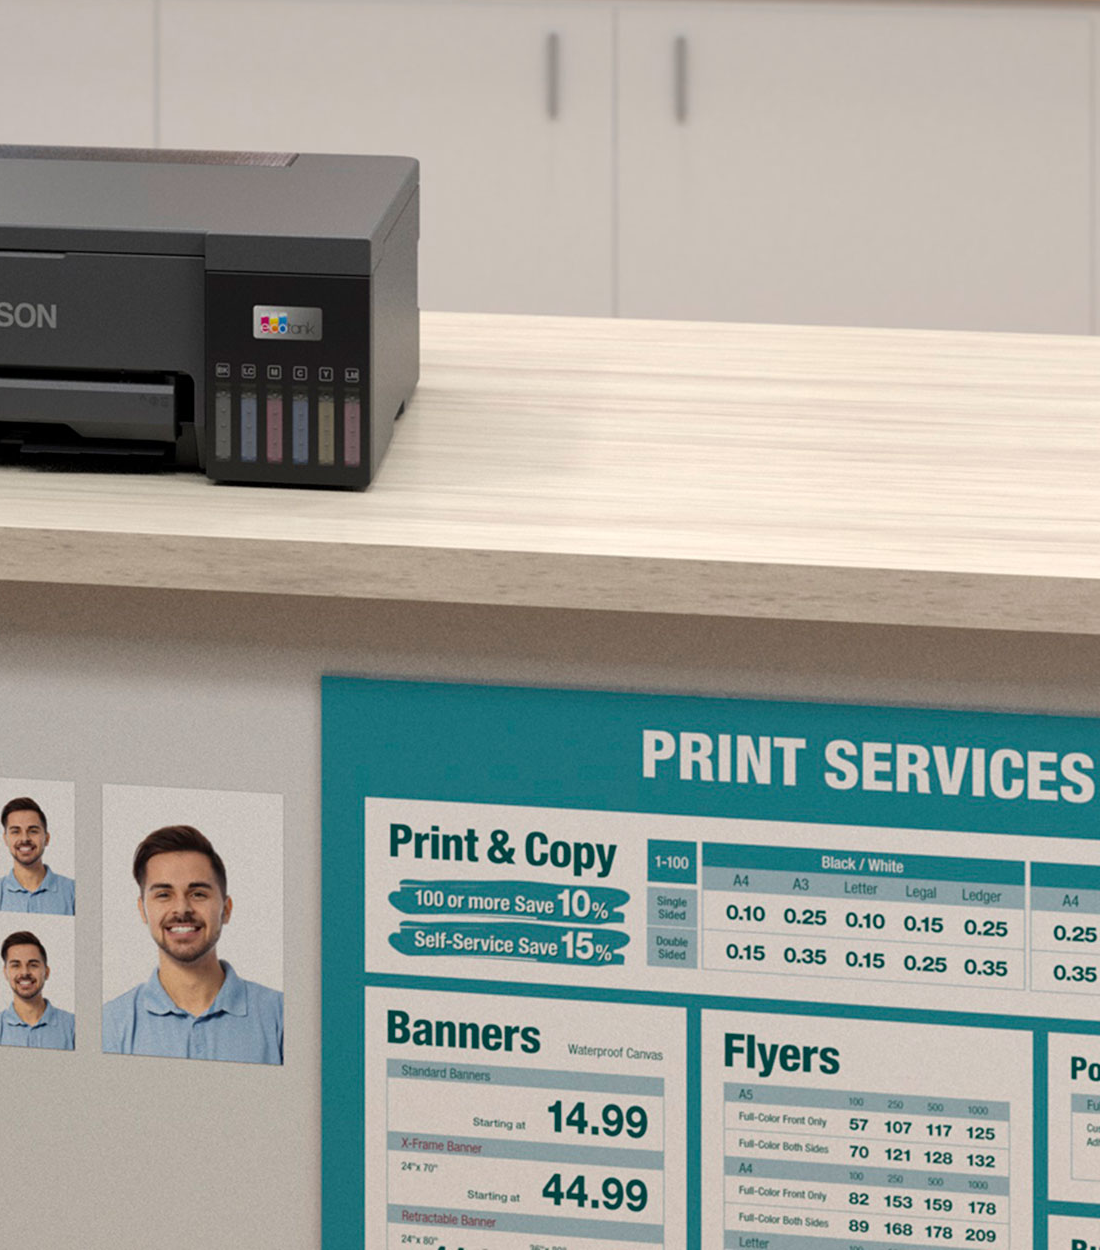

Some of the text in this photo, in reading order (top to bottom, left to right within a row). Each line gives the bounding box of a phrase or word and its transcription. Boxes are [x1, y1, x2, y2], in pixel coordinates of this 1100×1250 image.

[642, 729, 1095, 804] PRINT SERVICES
[389, 823, 617, 878] Print & Copy
[655, 855, 689, 870] 1-100
[821, 856, 857, 871] Black
[868, 858, 904, 874] White
[733, 874, 1002, 904] A4 A3 Letter Legal Ledger
[415, 888, 609, 919] 100 or more Save 10%
[656, 895, 687, 908] Single
[1062, 895, 1079, 908] A4
[658, 908, 686, 921] Sided
[726, 905, 1008, 938] 0.10 0.25 0.10 0.15 0.25
[656, 936, 688, 948] Double
[1053, 925, 1097, 943] 0.25
[414, 931, 612, 961] Self-Service Save 15%
[658, 948, 686, 961] Sided
[726, 944, 1008, 977] 0.15 0.35 0.15 0.25 0.35
[1053, 964, 1097, 983] 0.35
[387, 1009, 541, 1054] Banners
[568, 1043, 663, 1061] Waterproof Canvas
[724, 1033, 841, 1078] Flyers
[401, 1064, 491, 1081] Standard Banners
[1071, 1056, 1100, 1082] Po
[738, 1088, 753, 1100] A5
[848, 1097, 989, 1115] 100 250 500 1000
[473, 1116, 526, 1130] Starting at
[548, 1100, 648, 1139] 14.99
[738, 1111, 827, 1128] Full-Color Front Only
[849, 1118, 996, 1140] 57 107 117 125
[401, 1137, 482, 1154] X-Frame Banner
[738, 1138, 829, 1154] Full-Color Both Sides
[849, 1145, 996, 1168] 70 121 128 132
[738, 1162, 753, 1174] A4
[848, 1171, 988, 1190] 100 250 500 1000
[467, 1189, 521, 1203] Starting at
[542, 1173, 648, 1212] 44.99
[738, 1185, 827, 1202] Full-Color Front Only
[848, 1192, 996, 1215] 82 153 159 178
[401, 1209, 496, 1228] Retractable Banner
[738, 1212, 829, 1228] Full-Color Both Sides
[848, 1219, 996, 1242] 89 168 178 209
[739, 1237, 769, 1249] Letter
